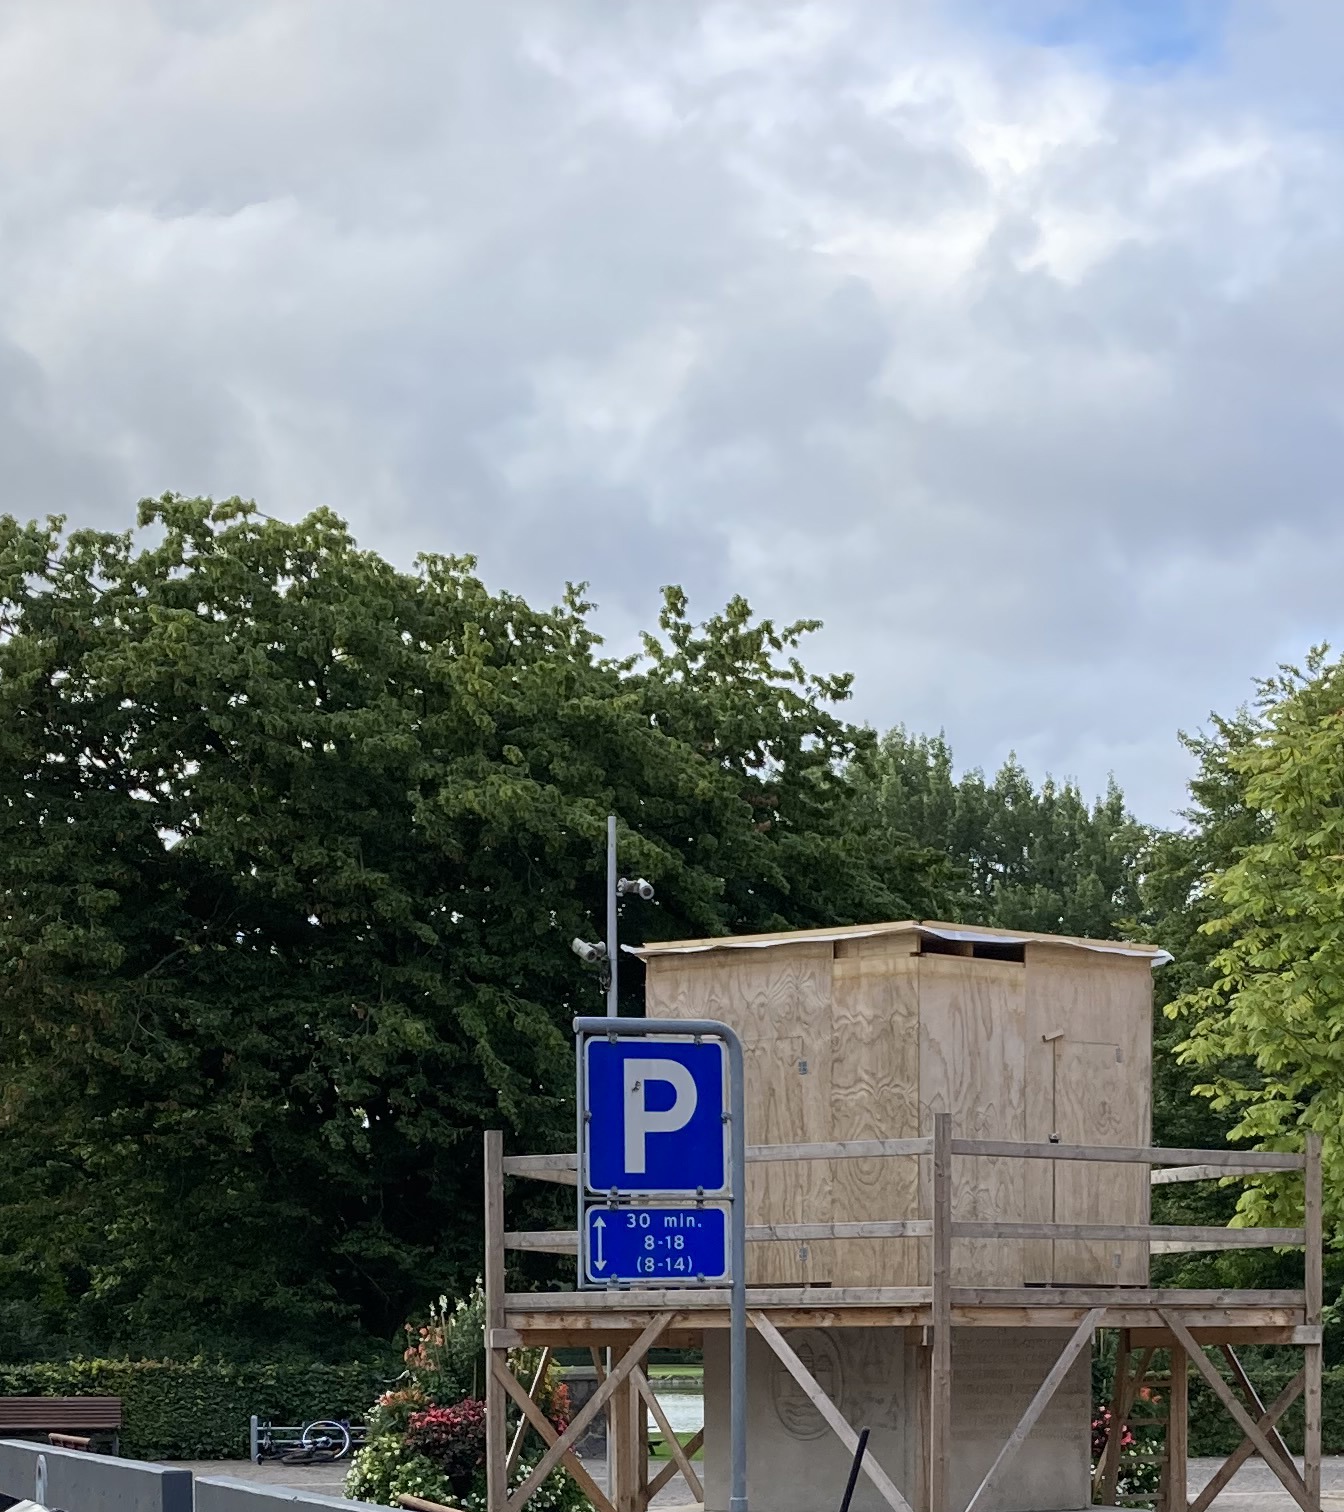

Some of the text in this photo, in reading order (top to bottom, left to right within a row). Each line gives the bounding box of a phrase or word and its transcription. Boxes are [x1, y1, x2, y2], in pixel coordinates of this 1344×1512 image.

[623, 1058, 698, 1174] P
[626, 1213, 651, 1229] 30
[643, 1235, 685, 1250] 8-18
[636, 1256, 694, 1273] (8-14)
